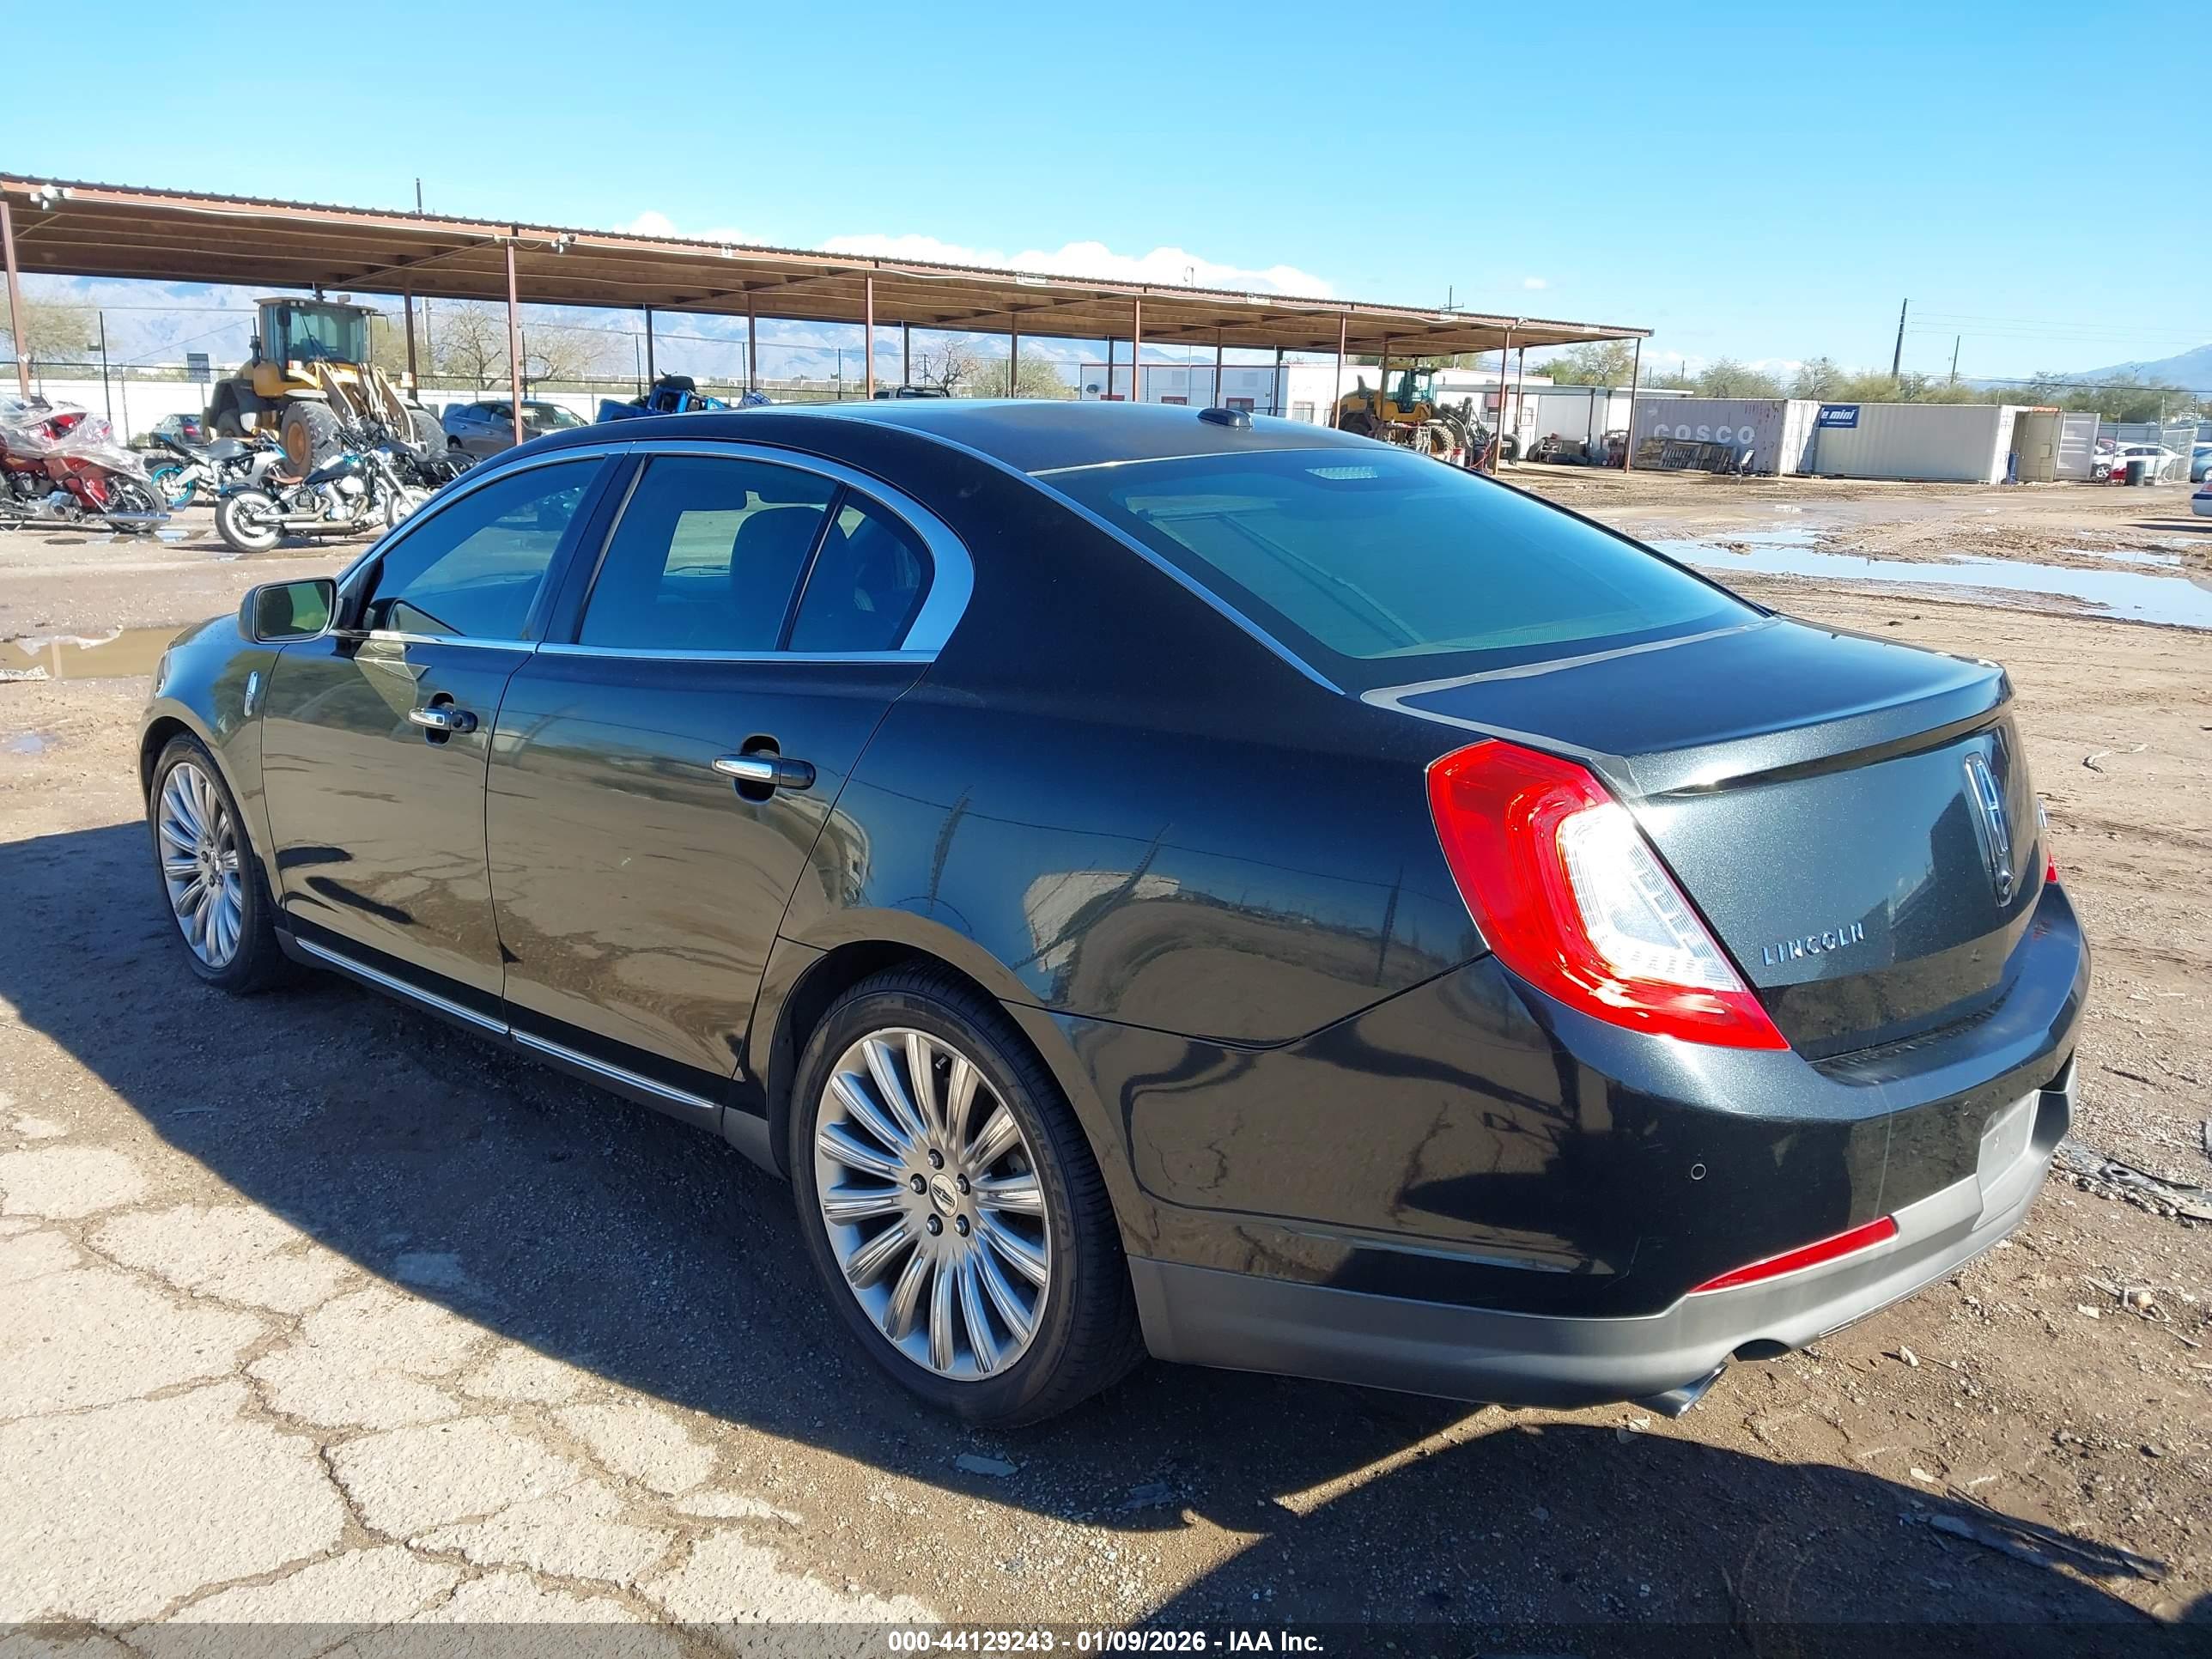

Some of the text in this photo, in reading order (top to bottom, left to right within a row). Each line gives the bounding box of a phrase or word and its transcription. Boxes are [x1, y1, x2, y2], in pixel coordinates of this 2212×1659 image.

[1829, 409, 1856, 420] mini
[1654, 423, 1755, 445] COSCO
[1762, 922, 1864, 967] LINCOLN
